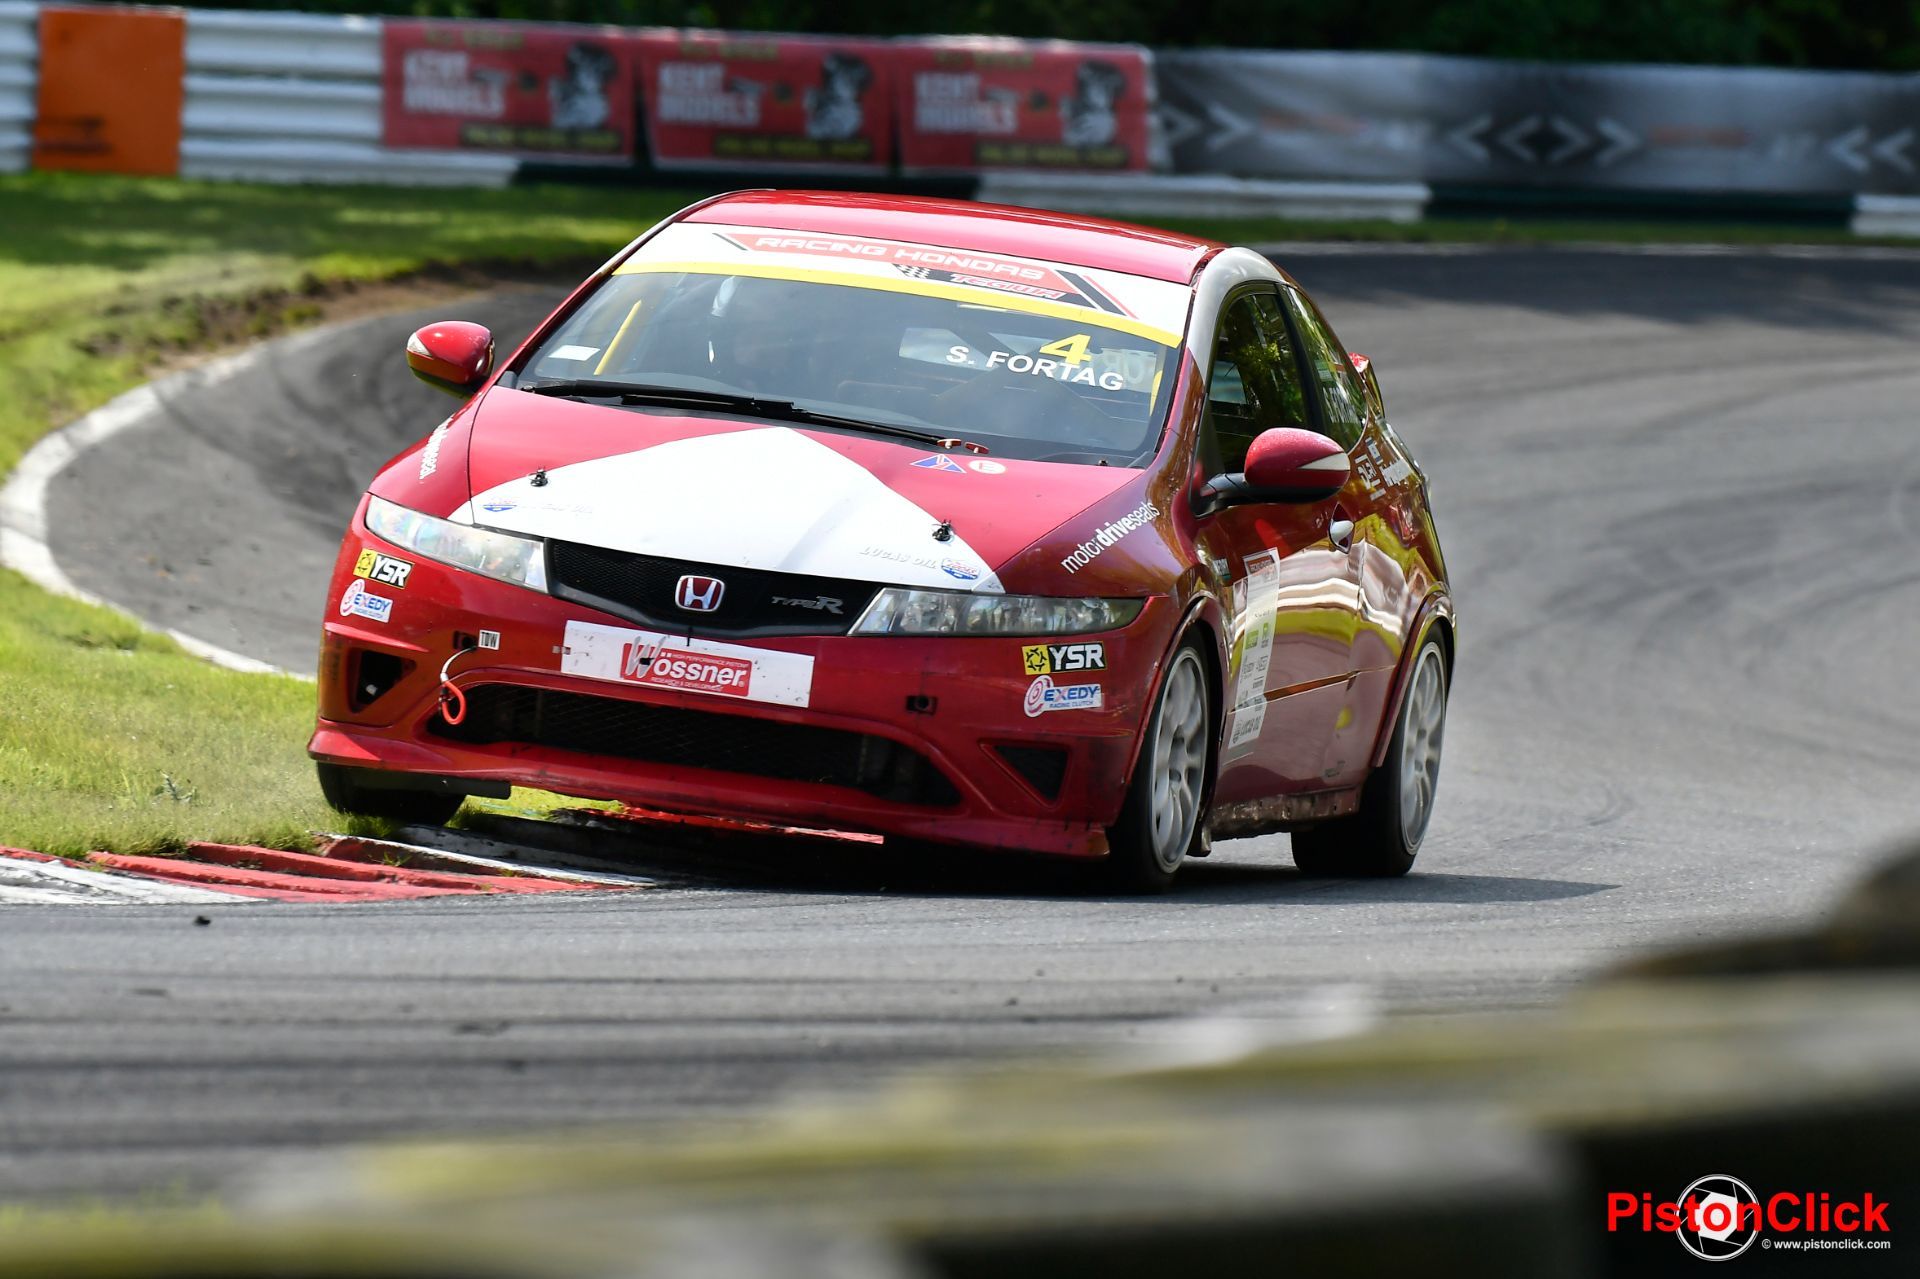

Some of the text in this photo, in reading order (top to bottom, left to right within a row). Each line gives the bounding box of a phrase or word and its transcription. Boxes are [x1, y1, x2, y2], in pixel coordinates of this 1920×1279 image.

[756, 236, 1045, 280] RACING HONDAS
[1039, 333, 1093, 365] 4
[946, 345, 975, 365] S.
[986, 351, 1124, 391] FORTAG
[1061, 498, 1160, 574] motordriveseats
[370, 555, 412, 587] YSR
[354, 593, 391, 613] EXEDY
[481, 631, 498, 648] TOW
[1048, 644, 1105, 671] YSR
[1044, 685, 1099, 702] EXEDY
